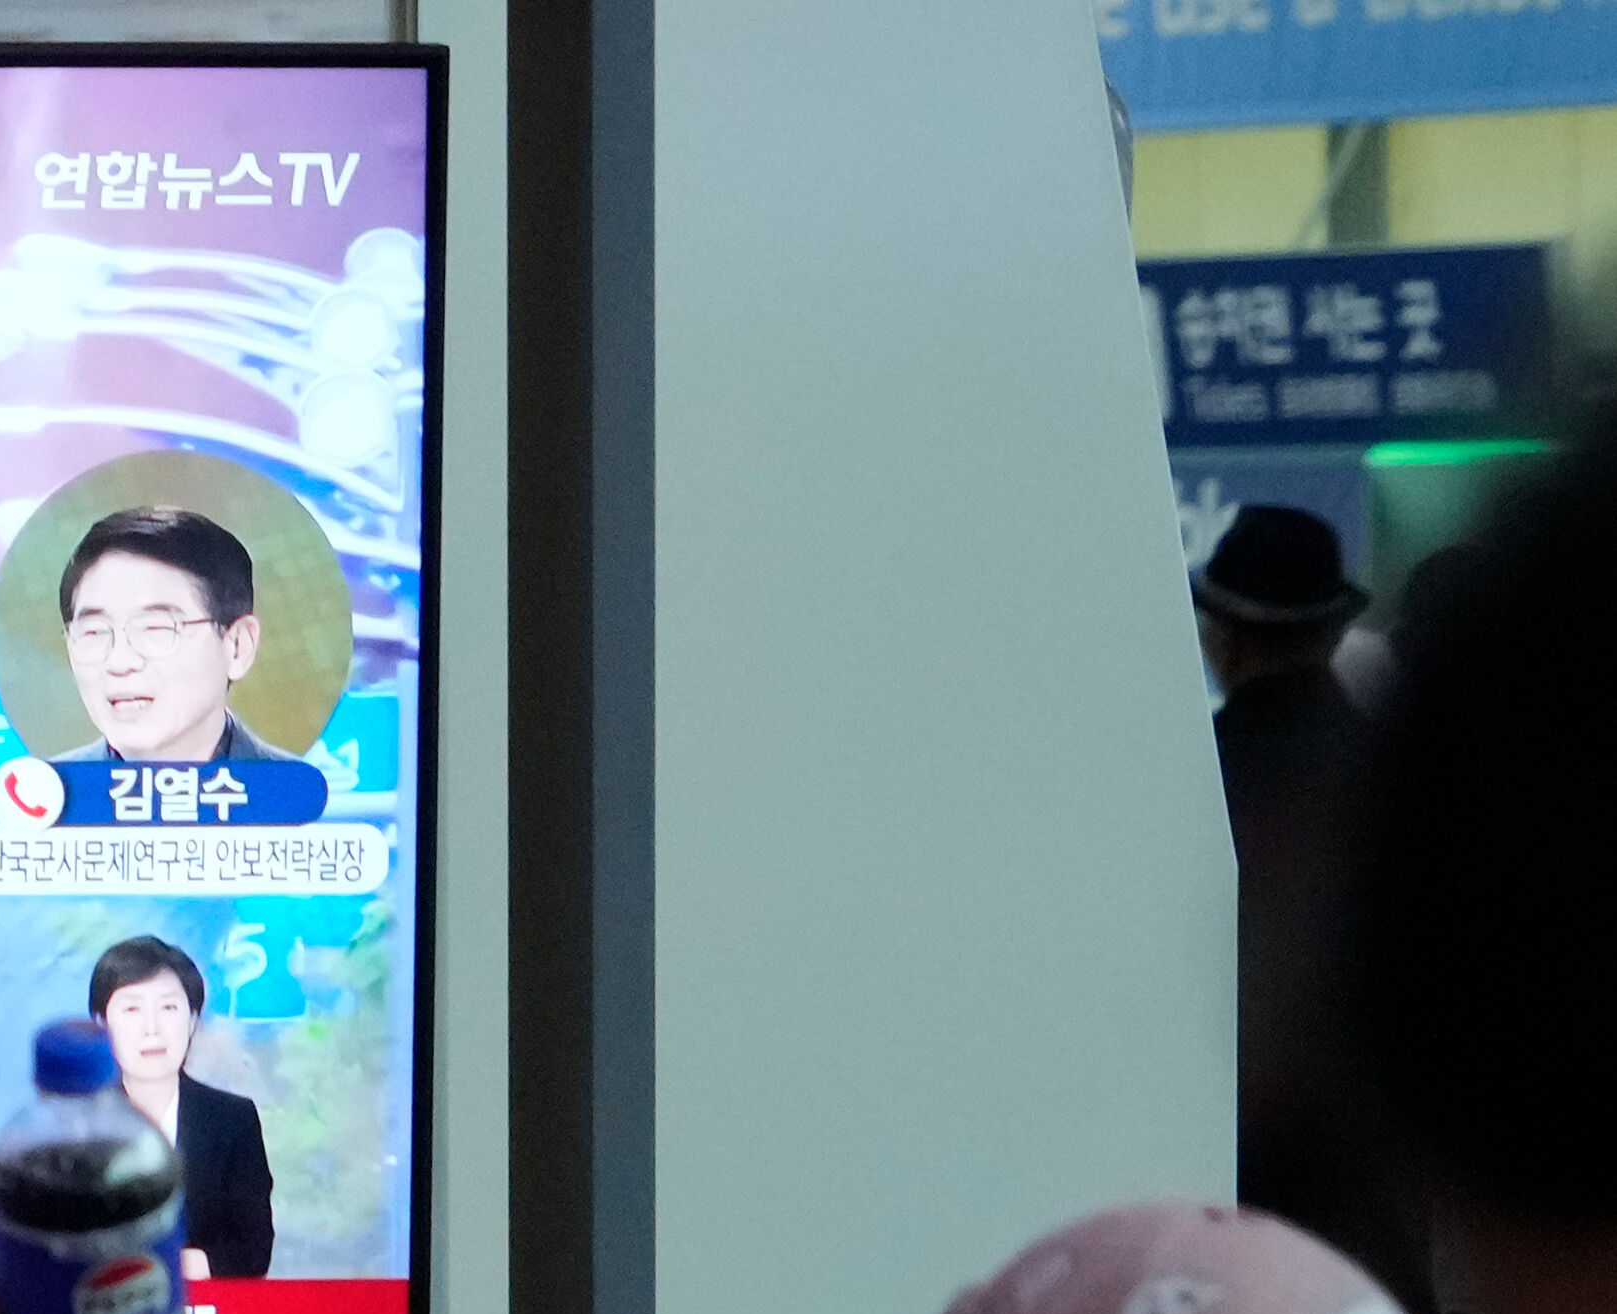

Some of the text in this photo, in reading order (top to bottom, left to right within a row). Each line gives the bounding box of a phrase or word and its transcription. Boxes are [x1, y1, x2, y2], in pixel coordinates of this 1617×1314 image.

[34, 151, 360, 210] 연합뉴스TV
[109, 767, 249, 822] 김열수
[216, 839, 365, 882] 안보전략실장
